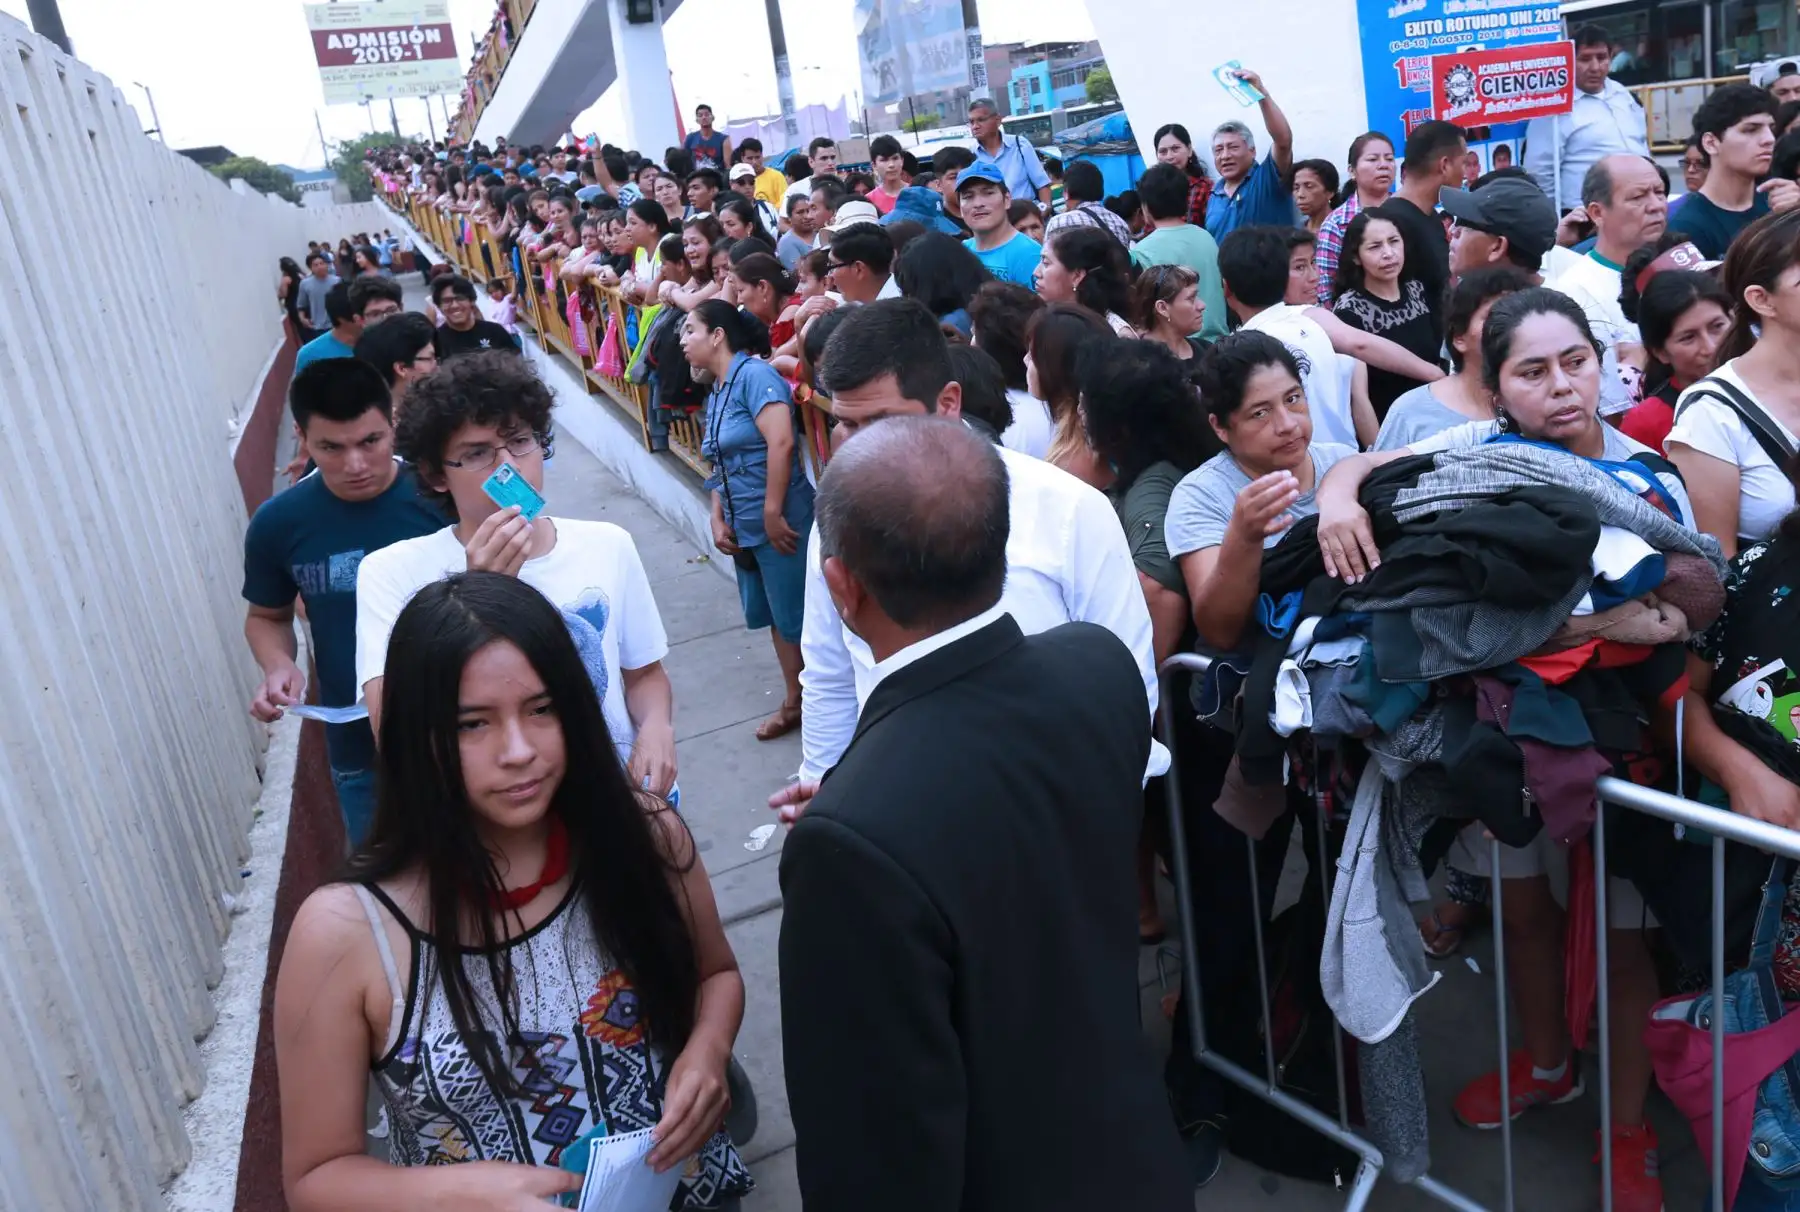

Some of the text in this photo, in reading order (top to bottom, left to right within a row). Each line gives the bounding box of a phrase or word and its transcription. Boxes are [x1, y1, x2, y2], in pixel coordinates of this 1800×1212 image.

[1405, 19, 1443, 37] EXITO
[1446, 12, 1507, 33] ROTUNDO
[1510, 10, 1533, 26] UNI
[327, 25, 442, 49] ADMISIÓN
[1432, 33, 1473, 45] AGOSTO
[1479, 30, 1502, 40] 2018
[352, 44, 423, 64] 2019-1
[1480, 68, 1568, 97] CIENCIAS
